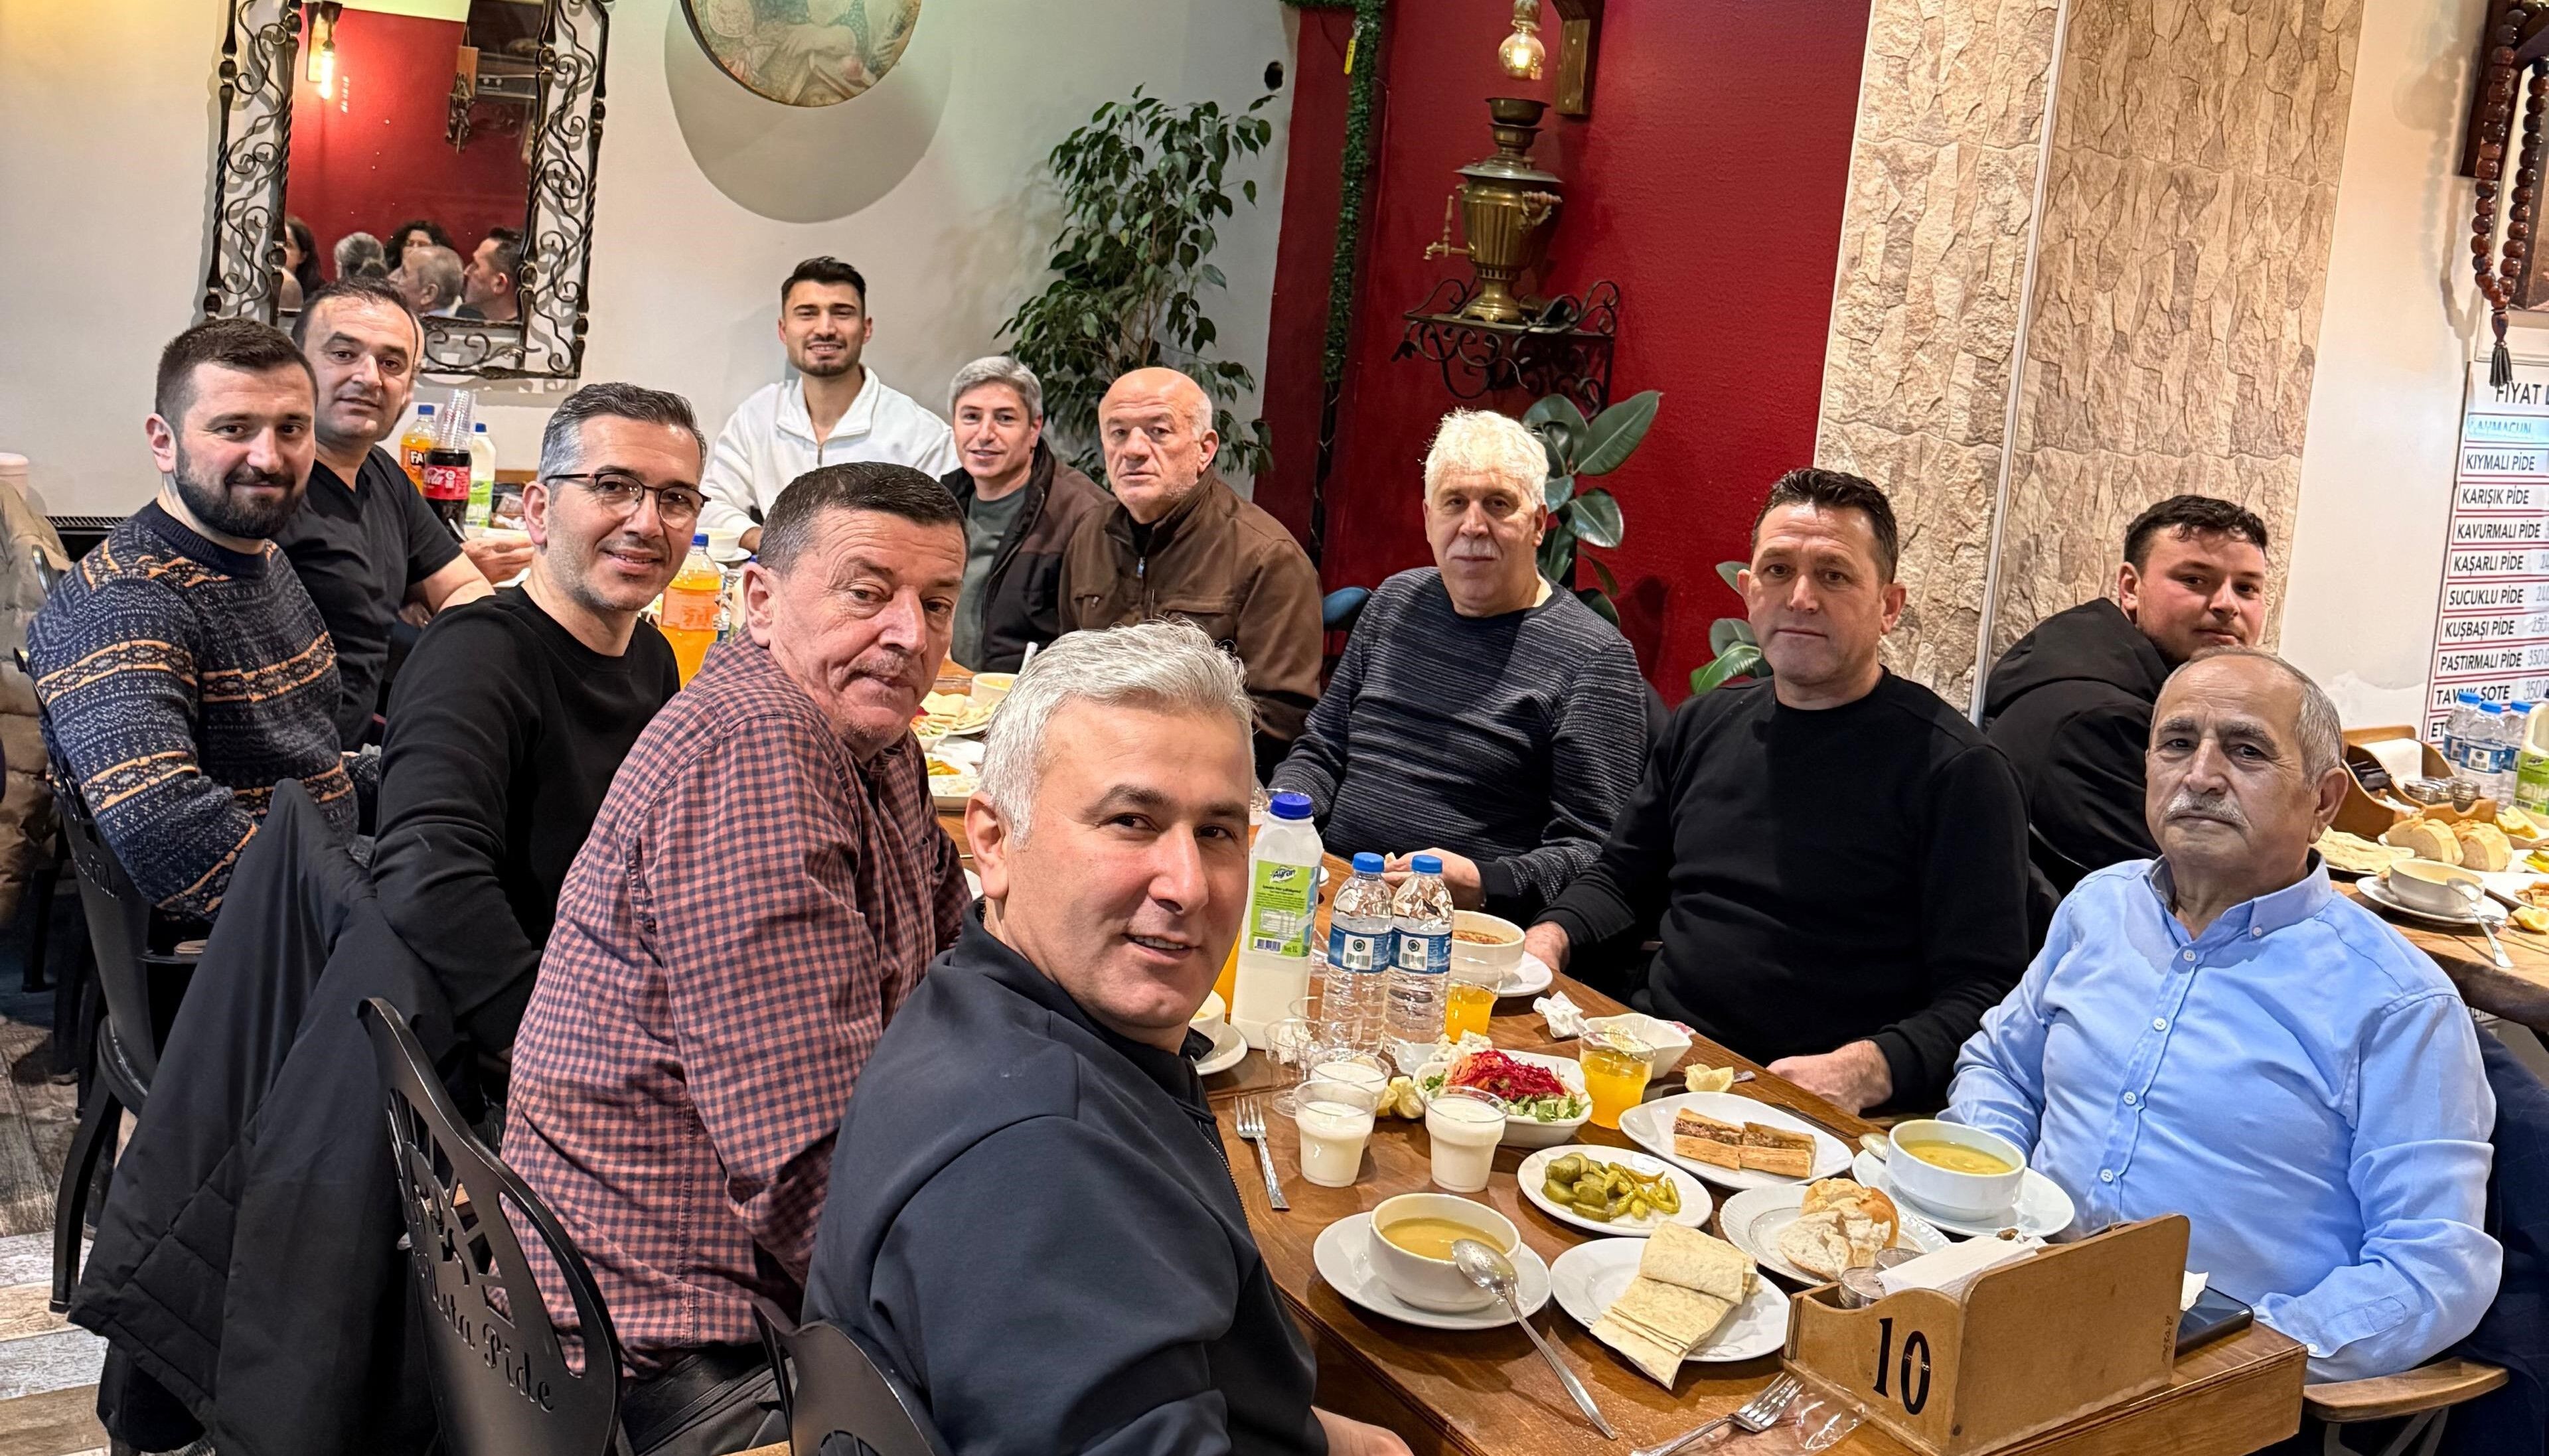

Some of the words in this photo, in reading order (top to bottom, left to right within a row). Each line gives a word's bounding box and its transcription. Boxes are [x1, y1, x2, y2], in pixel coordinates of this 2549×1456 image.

[2465, 454, 2510, 470] KIYMALI
[2511, 452, 2535, 471] PİDE
[2462, 488, 2505, 508] KARIŞIK
[2506, 485, 2530, 504] PİDE
[2457, 523, 2517, 539] KAVURMALI
[2518, 520, 2541, 538] PİDE
[2453, 555, 2498, 576] KAŞARLI
[2500, 551, 2524, 571] PİDE
[2449, 589, 2499, 605] SUCUKLU
[2500, 585, 2524, 604] PİDE
[2445, 621, 2489, 642] KUŞBAŞI
[2491, 617, 2514, 636] PİDE
[2440, 654, 2499, 672] PASTIRMALI
[2500, 649, 2522, 668] PİDE
[2481, 685, 2510, 701] SOTE
[1428, 936, 1440, 972] SAMSUN
[483, 1323, 554, 1413] Pide
[1873, 1317, 1930, 1415] 10
